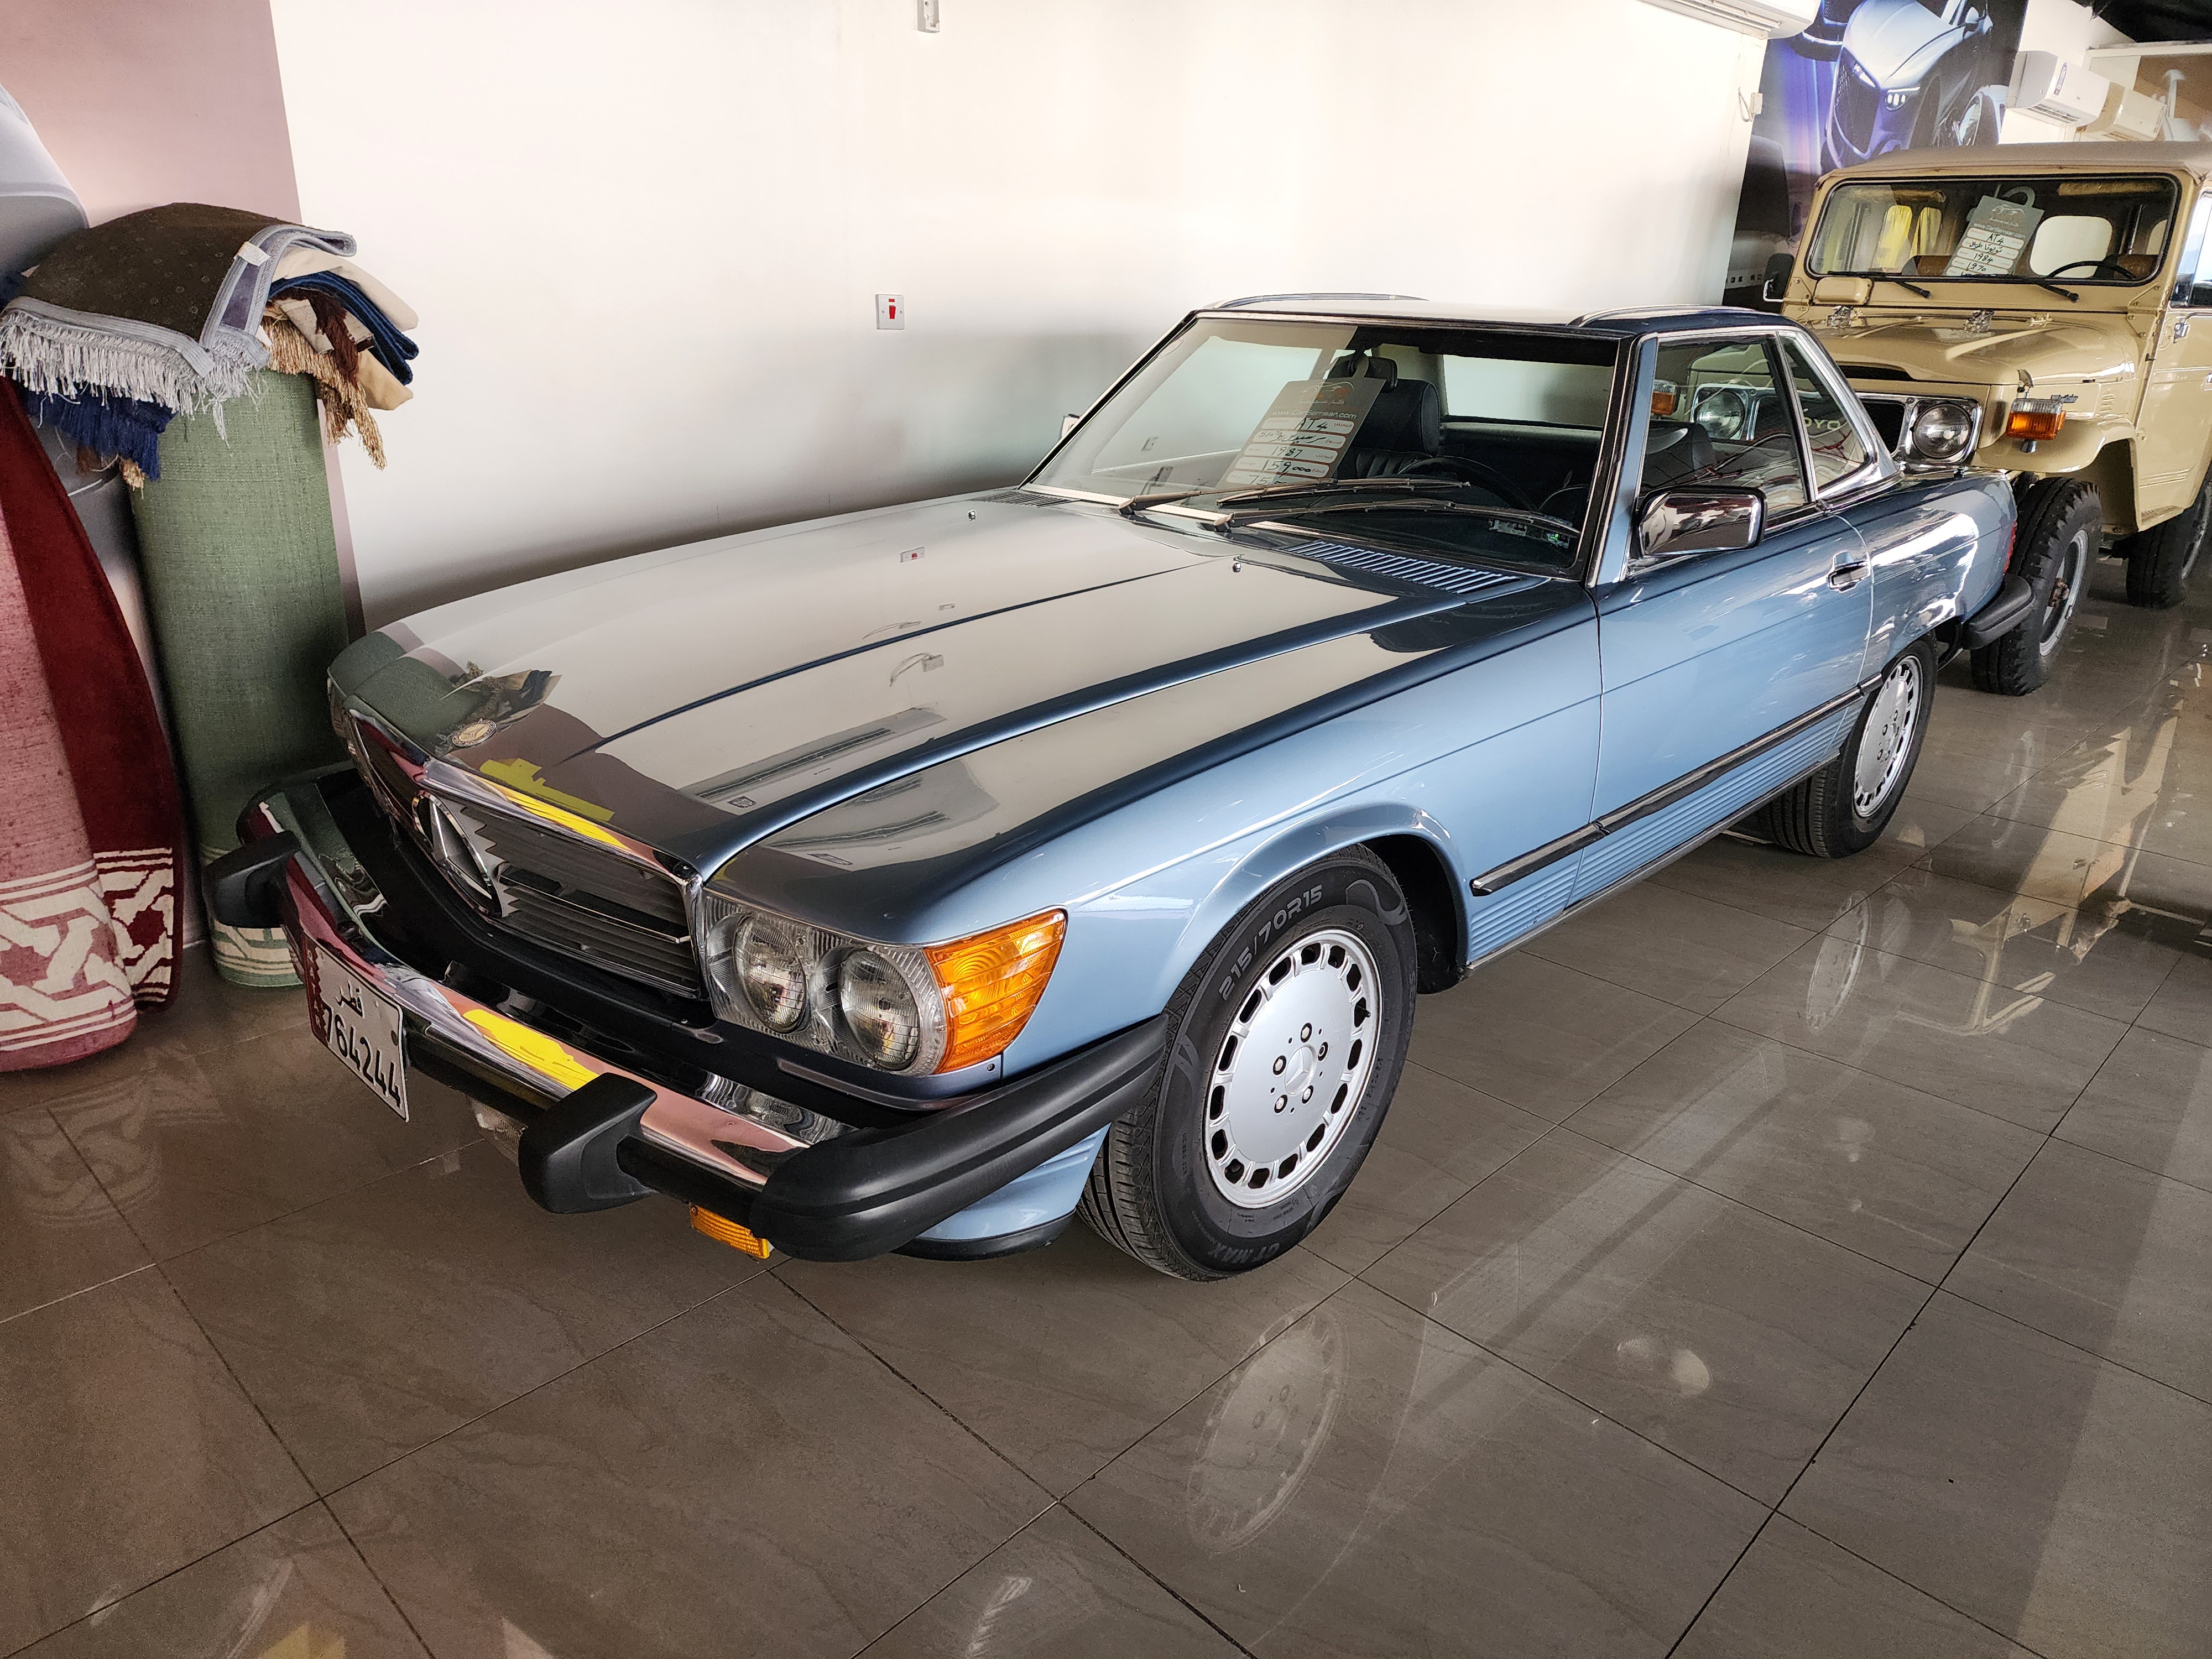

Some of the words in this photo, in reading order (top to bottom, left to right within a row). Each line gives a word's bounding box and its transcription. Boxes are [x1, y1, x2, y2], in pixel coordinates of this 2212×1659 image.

[1974, 253, 1994, 264] 1984
[1271, 446, 1303, 458] 1987
[1218, 884, 1323, 1001] 215/70R15
[336, 980, 365, 1018] قطر
[322, 999, 401, 1108] 764244
